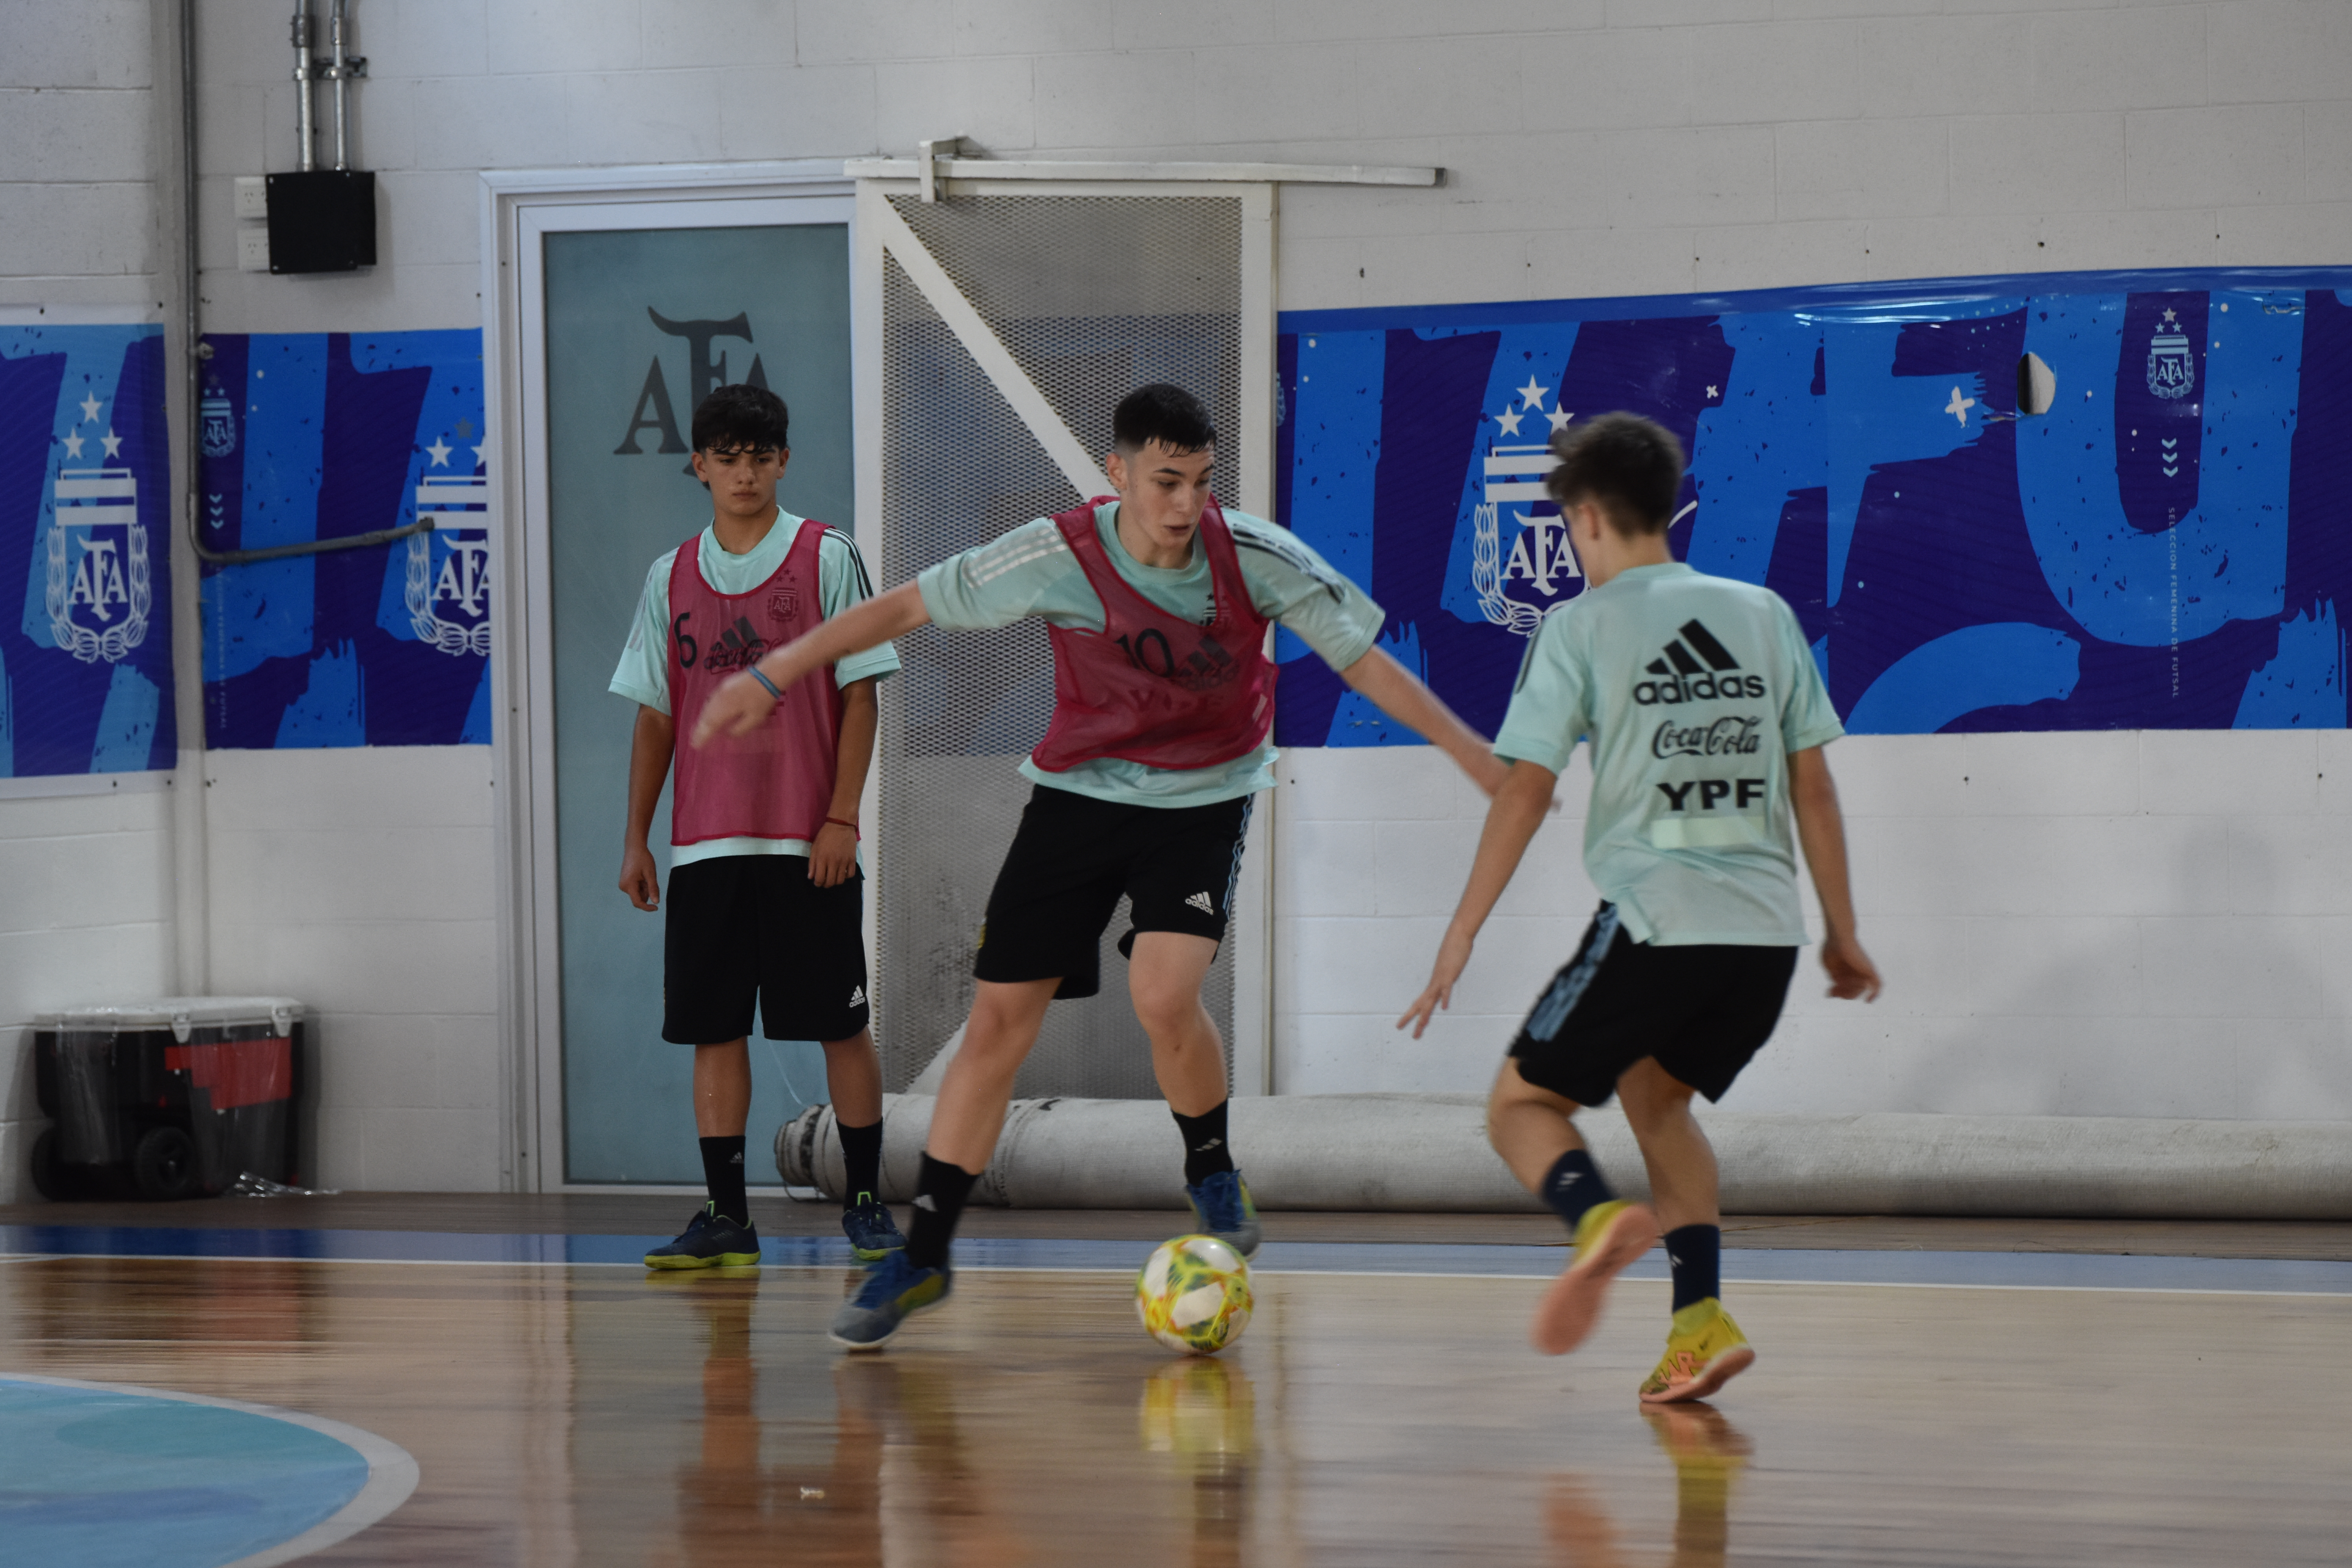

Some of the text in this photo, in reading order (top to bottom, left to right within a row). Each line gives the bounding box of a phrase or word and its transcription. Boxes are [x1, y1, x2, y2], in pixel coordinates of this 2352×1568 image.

[2157, 356, 2184, 386] AFA
[1499, 509, 1581, 596] AFA
[2169, 507, 2178, 570] SELECCION
[66, 534, 129, 621] AFA
[2170, 575, 2178, 633] FEMENINA
[674, 612, 697, 668] 6
[1114, 628, 1174, 678] 10
[2171, 637, 2178, 652] DE
[1633, 671, 1765, 706] adidas
[1656, 779, 1765, 811] YPF
